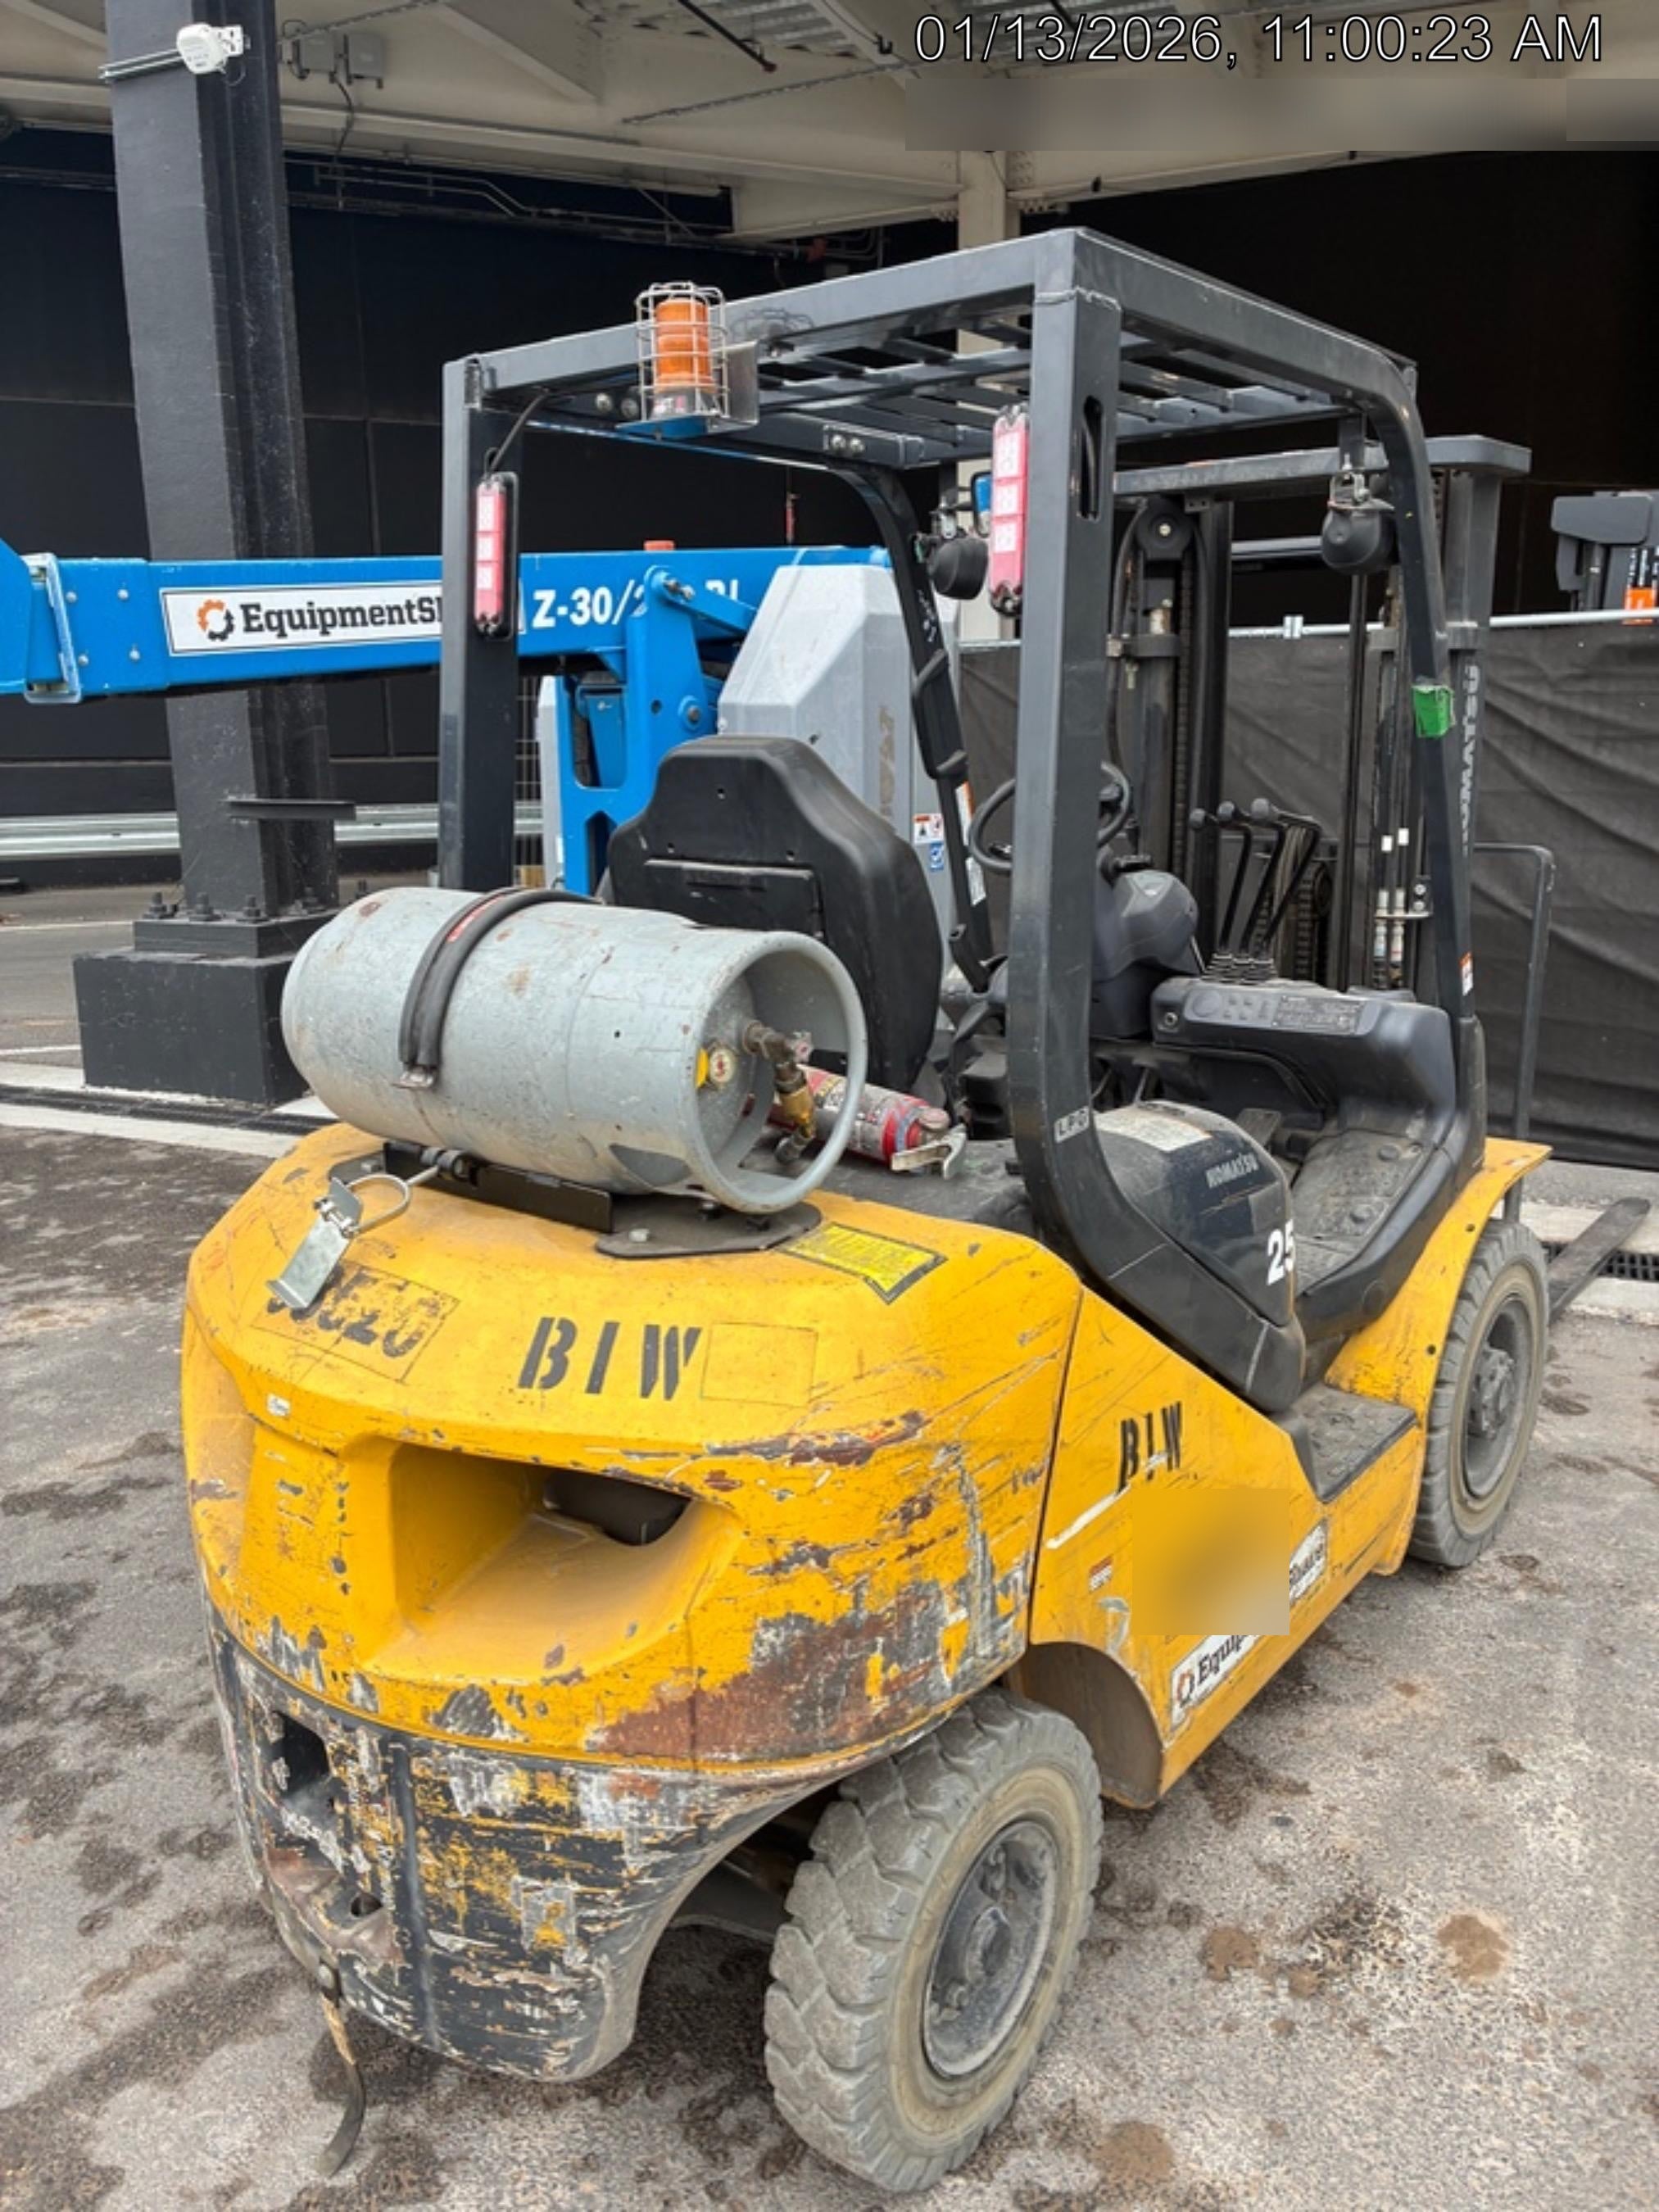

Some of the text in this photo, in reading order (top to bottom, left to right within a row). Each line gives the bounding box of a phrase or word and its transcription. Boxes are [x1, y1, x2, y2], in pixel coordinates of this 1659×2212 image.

[1267, 1218, 1296, 1286] 25
[517, 1317, 703, 1401] BIW
[1117, 1399, 1182, 1494] BIW
